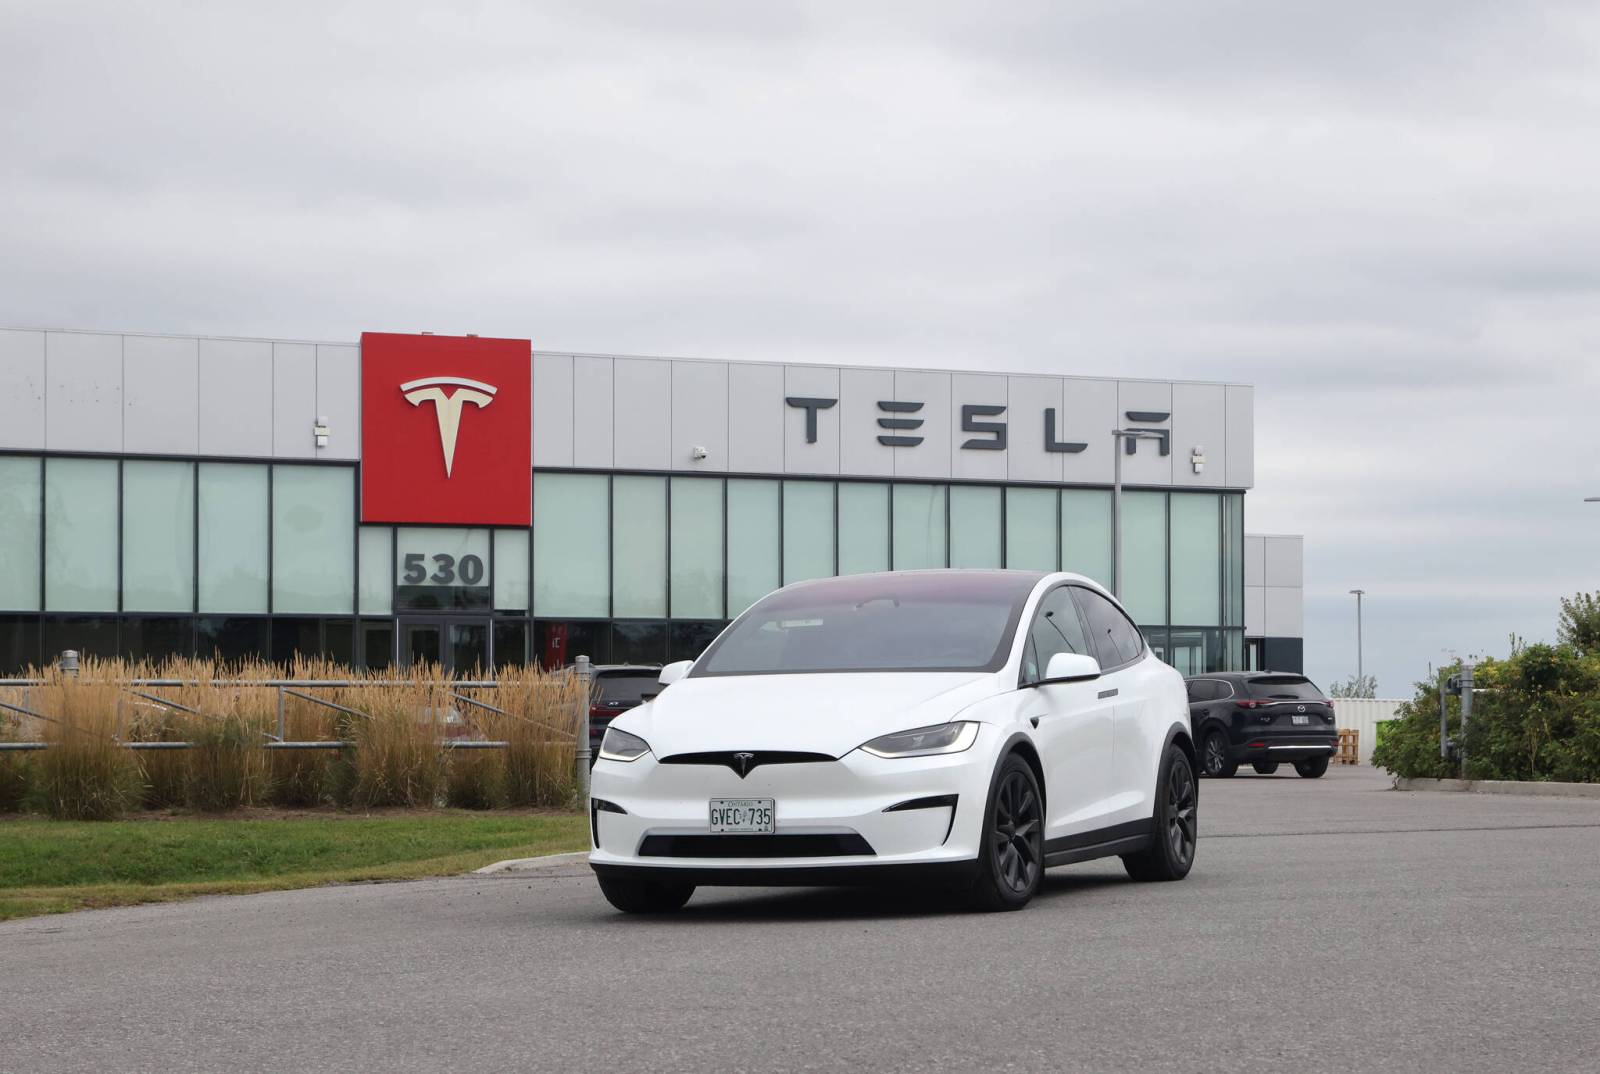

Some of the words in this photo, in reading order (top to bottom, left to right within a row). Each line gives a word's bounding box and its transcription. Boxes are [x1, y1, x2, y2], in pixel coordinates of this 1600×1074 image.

[785, 397, 1171, 457] TESLA
[403, 553, 485, 585] 530
[711, 808, 740, 825] GVEC
[748, 808, 771, 825] 735
